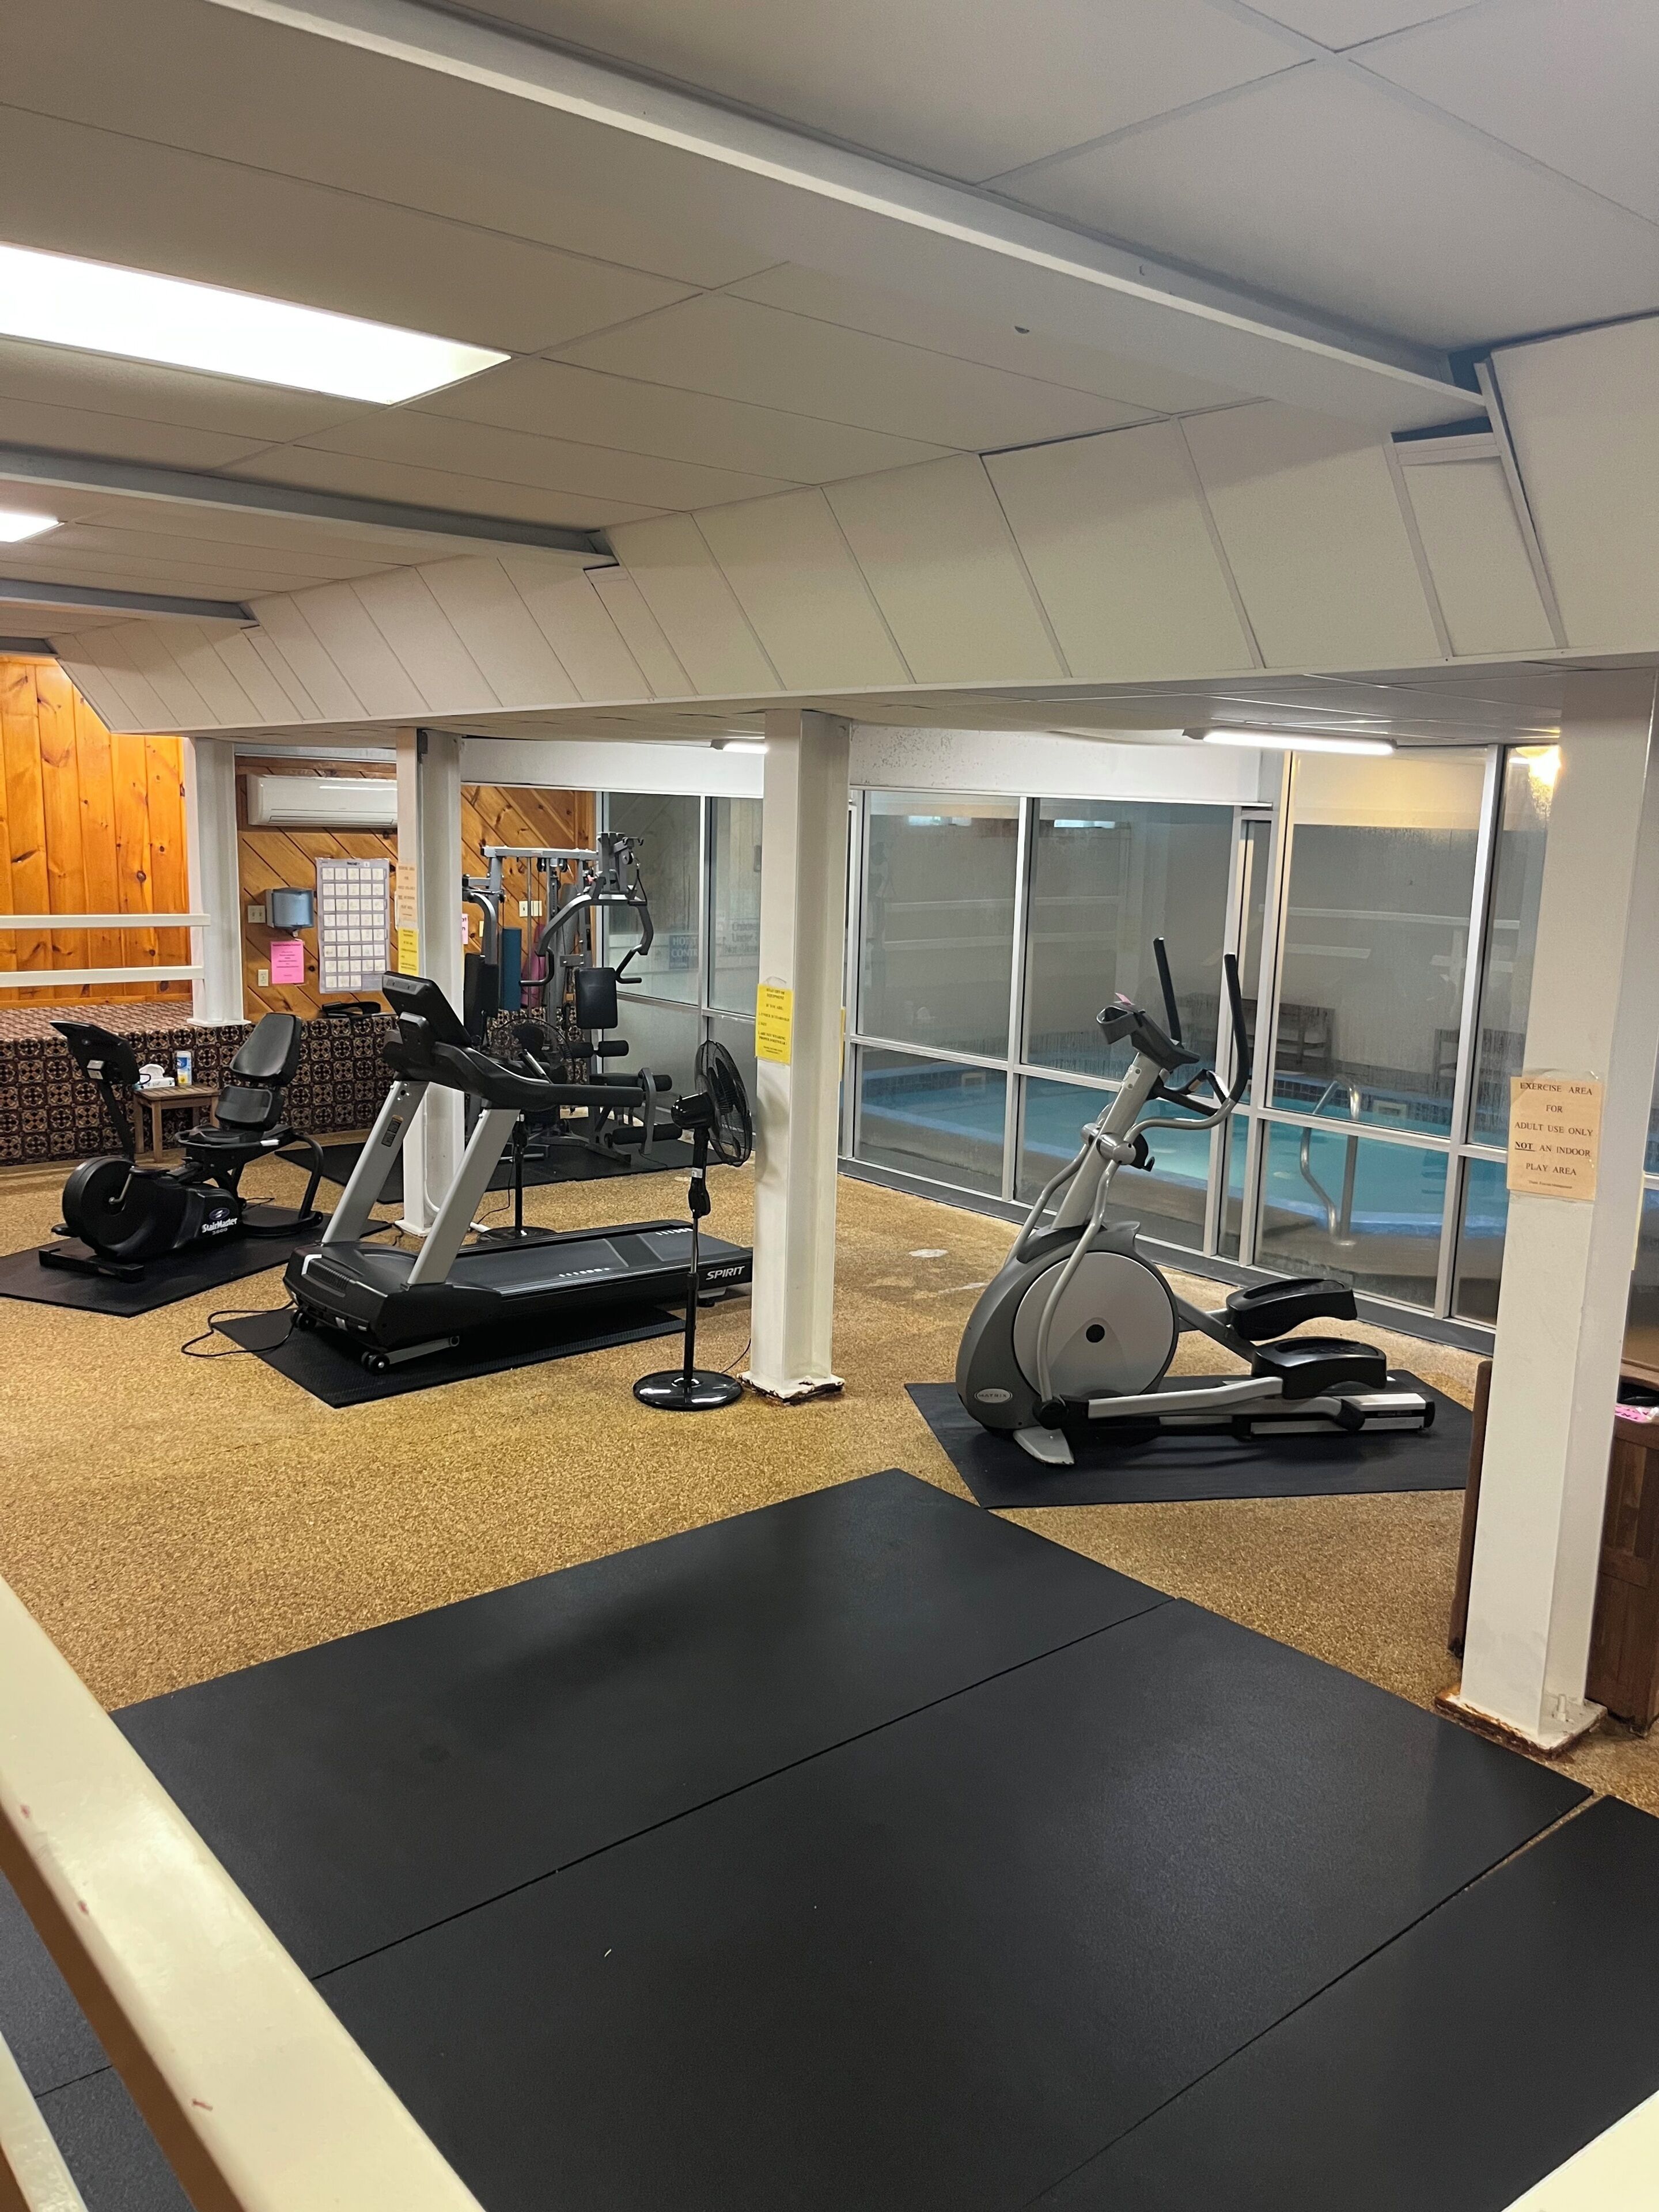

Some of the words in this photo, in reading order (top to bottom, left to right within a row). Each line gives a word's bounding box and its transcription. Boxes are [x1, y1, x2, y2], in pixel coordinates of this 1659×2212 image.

[1520, 1082, 1562, 1092] EXERCISE
[1569, 1086, 1593, 1096] AREA
[1546, 1104, 1563, 1113] FOR
[1514, 1122, 1544, 1131] ADULT
[1548, 1125, 1564, 1133] USE
[1568, 1127, 1593, 1137] ONLY
[1514, 1141, 1533, 1150] NOT
[1556, 1146, 1590, 1157] INDOOR
[1526, 1162, 1548, 1172] PLAY
[1552, 1166, 1577, 1176] AREA
[202, 1218, 238, 1233] StairMaster
[706, 1266, 745, 1281] SPIRIT
